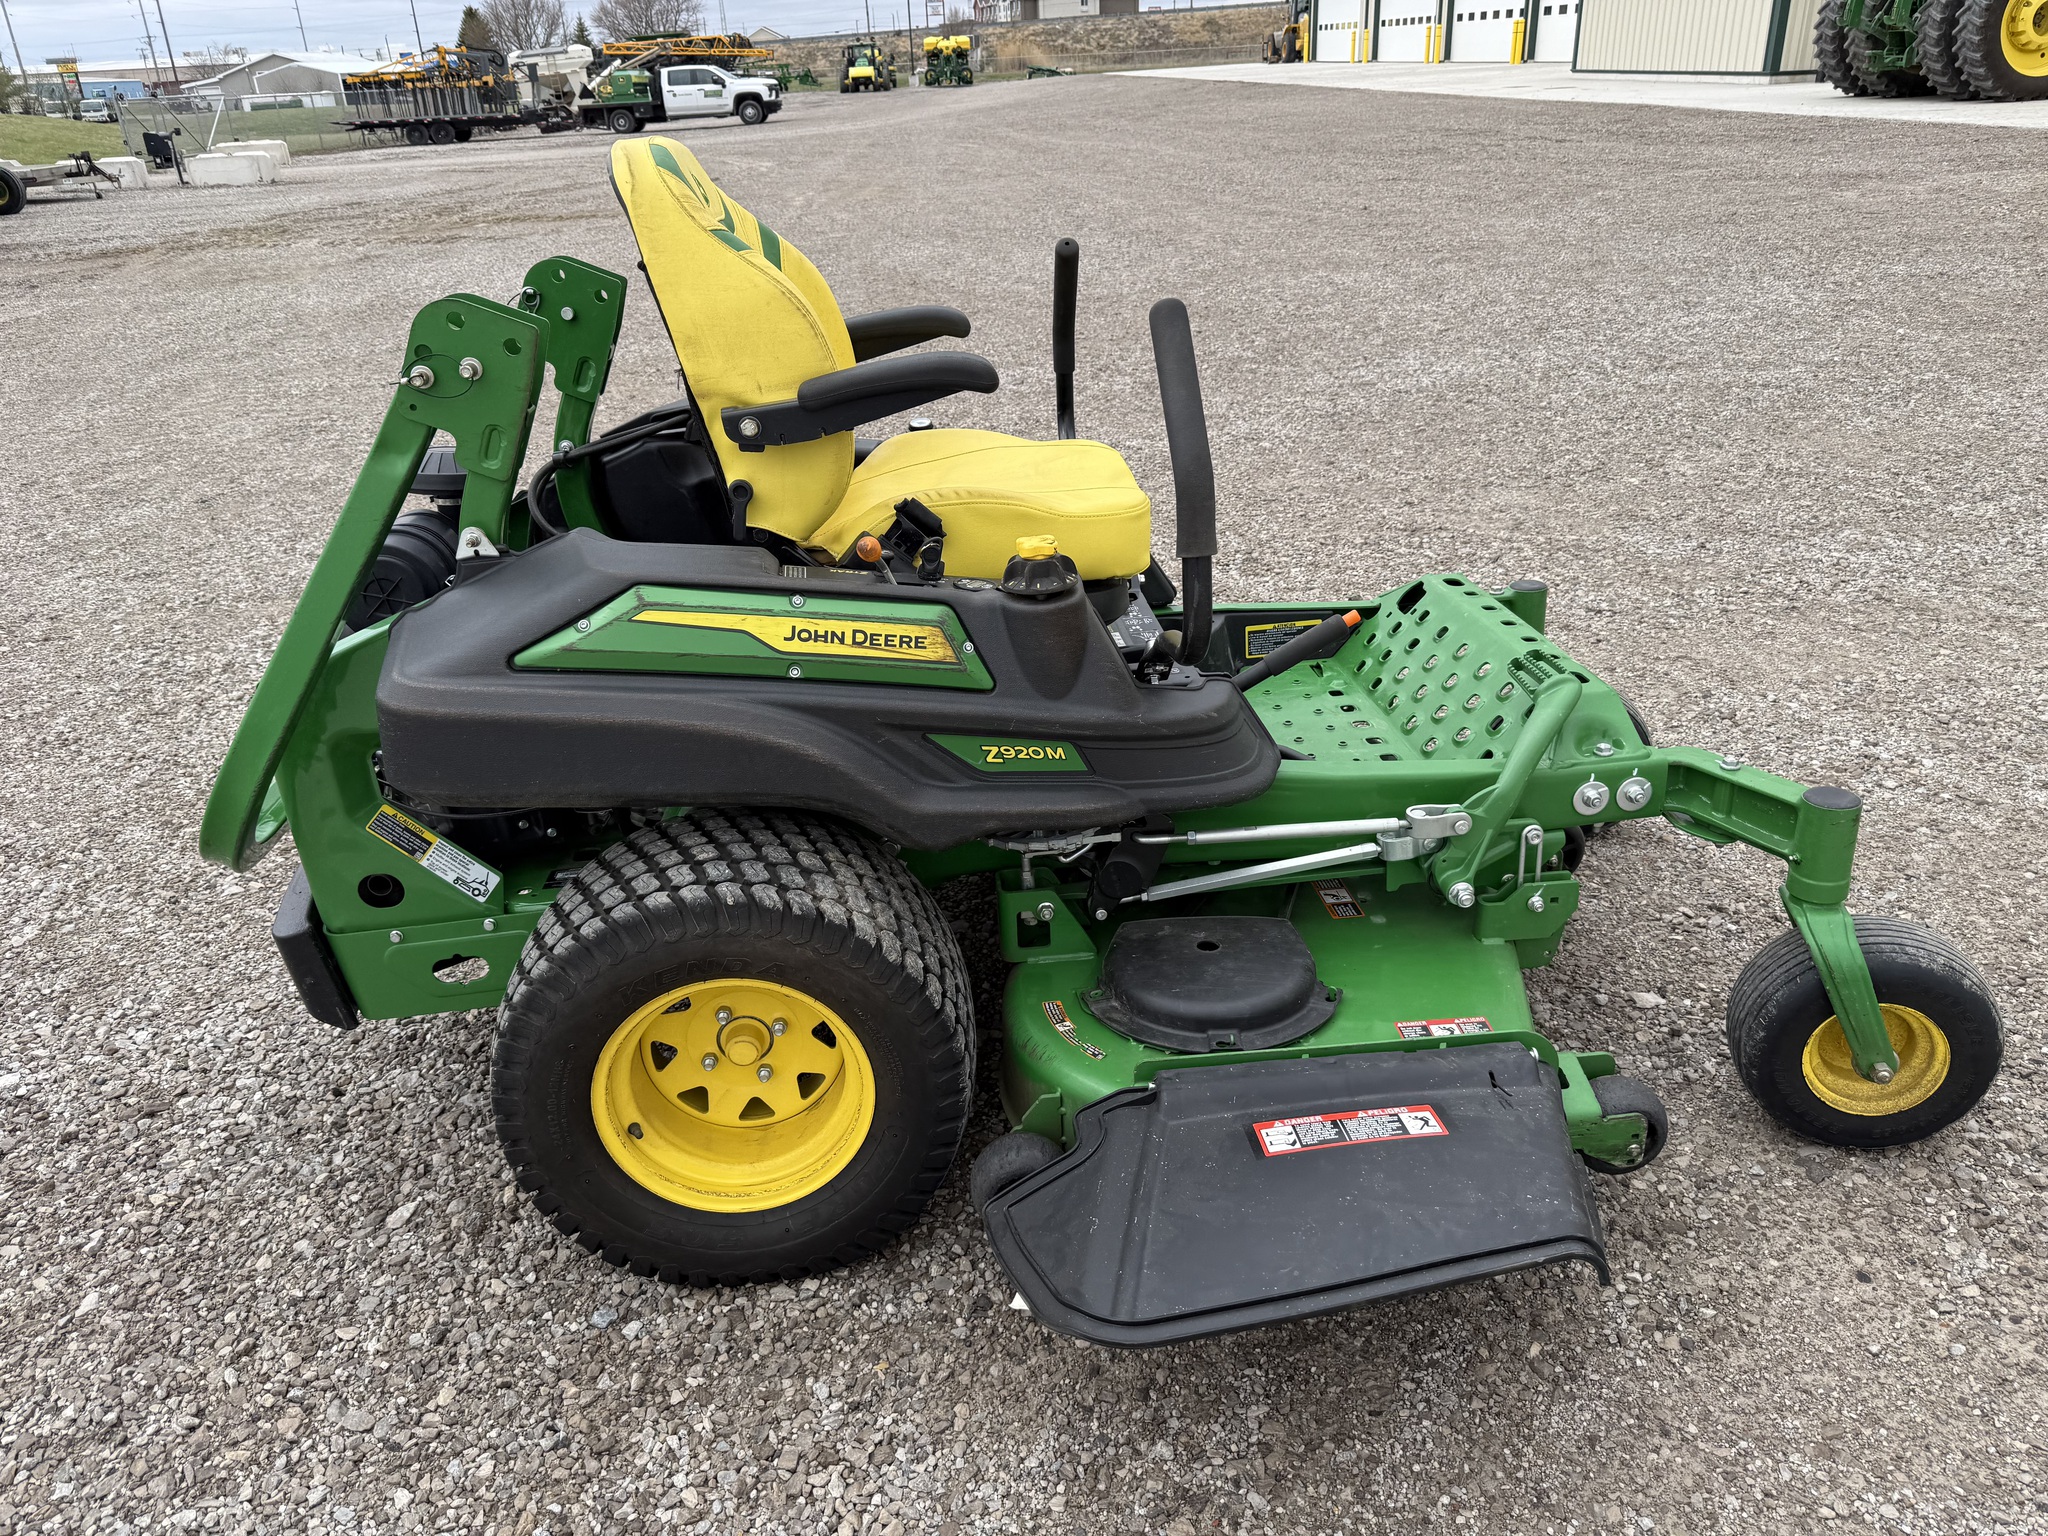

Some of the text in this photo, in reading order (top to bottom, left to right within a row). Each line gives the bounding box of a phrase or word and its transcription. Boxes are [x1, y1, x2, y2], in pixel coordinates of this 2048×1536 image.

[784, 625, 928, 650] JOHN DEERE
[981, 746, 1066, 763] Z920M
[397, 816, 426, 836] CAUTION
[618, 958, 786, 1006] KENDA
[1366, 1107, 1408, 1116] PELIGRO
[1284, 1116, 1323, 1126] DANGER
